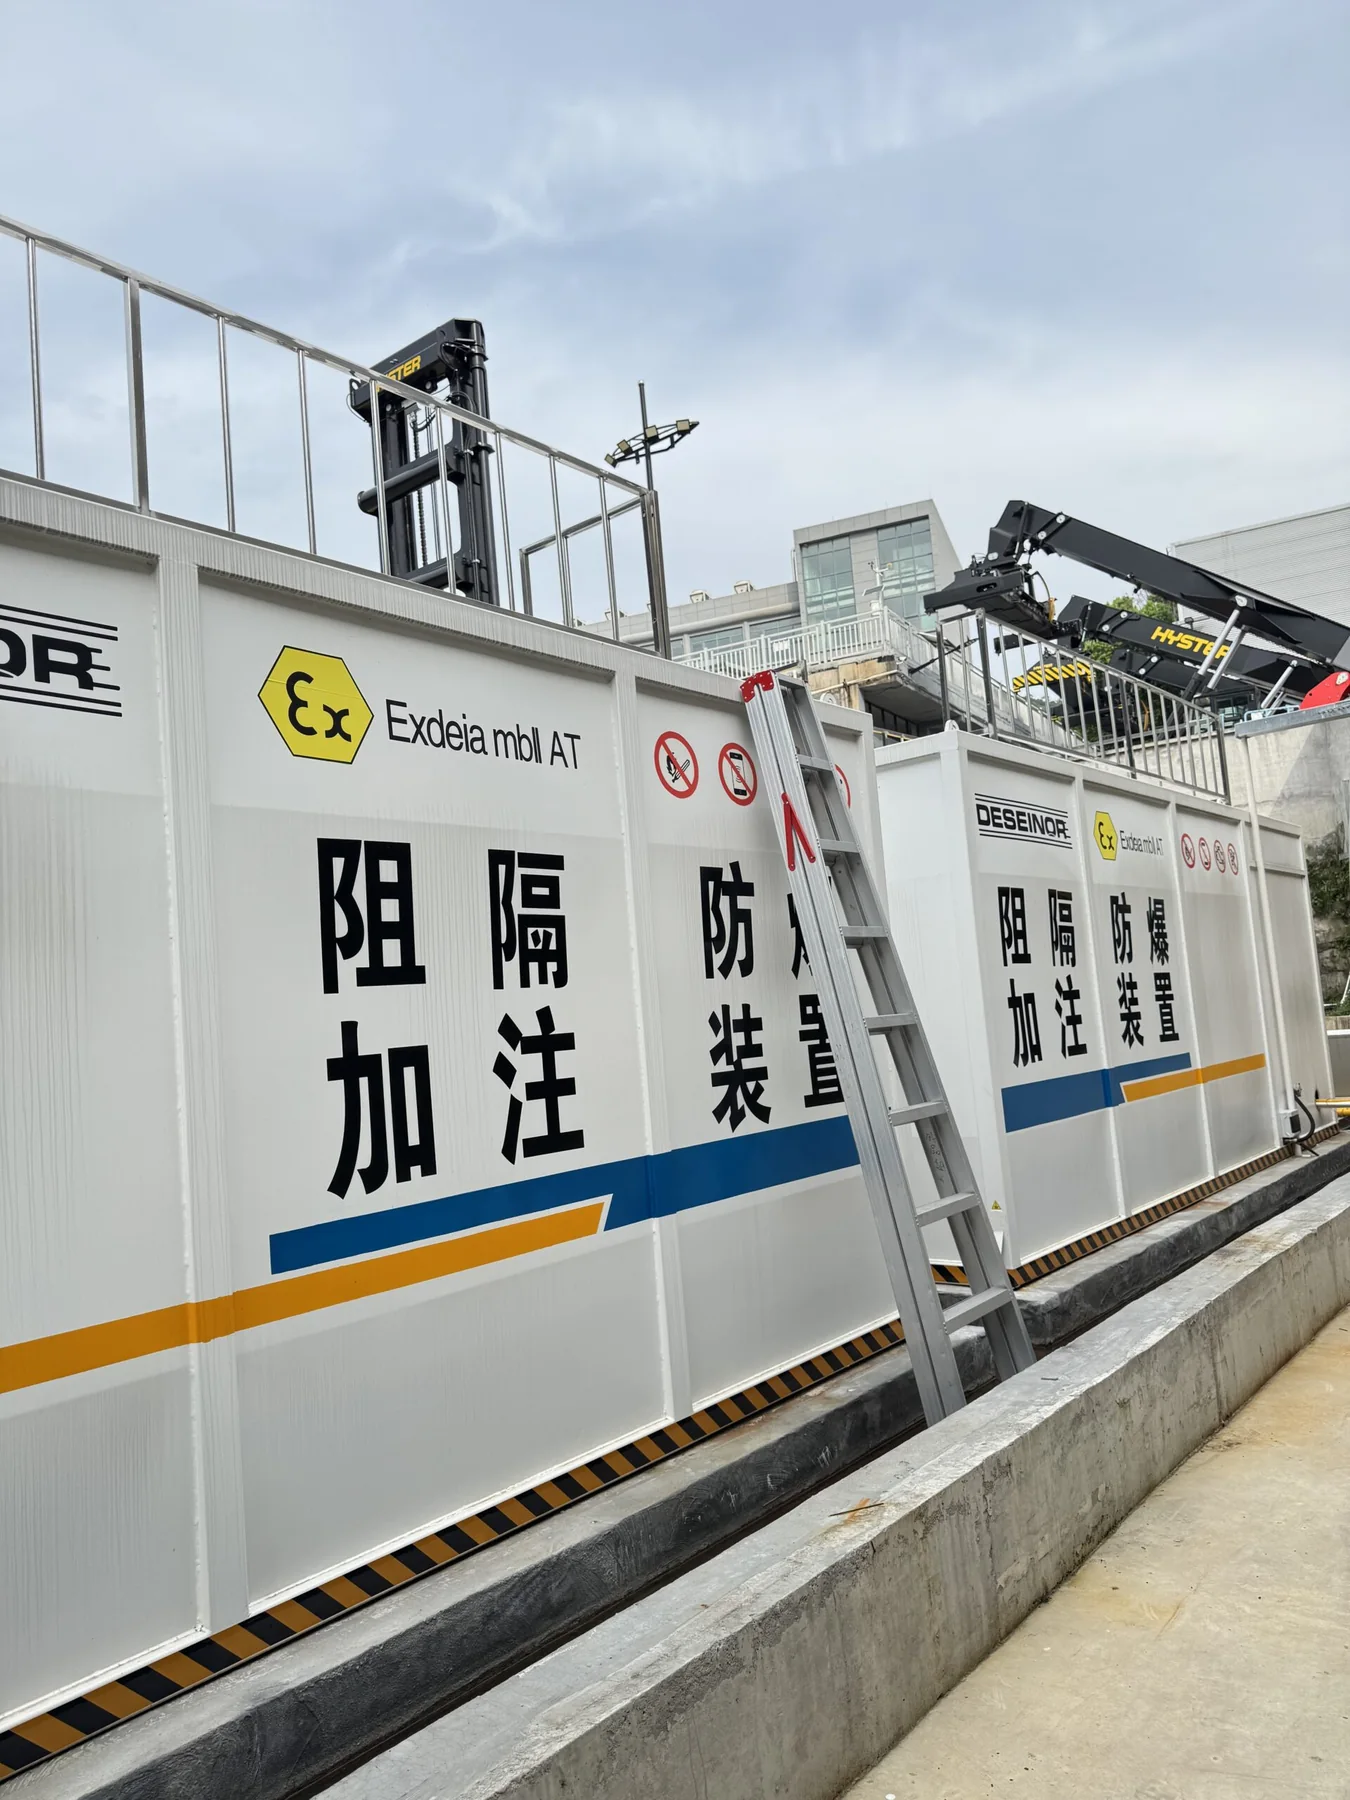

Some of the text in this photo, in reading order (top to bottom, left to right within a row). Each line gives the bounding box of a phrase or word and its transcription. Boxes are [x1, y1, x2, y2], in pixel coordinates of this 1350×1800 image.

[386, 699, 488, 756] Exdeia
[550, 731, 581, 770] AT
[976, 803, 1069, 839] DESEINOR
